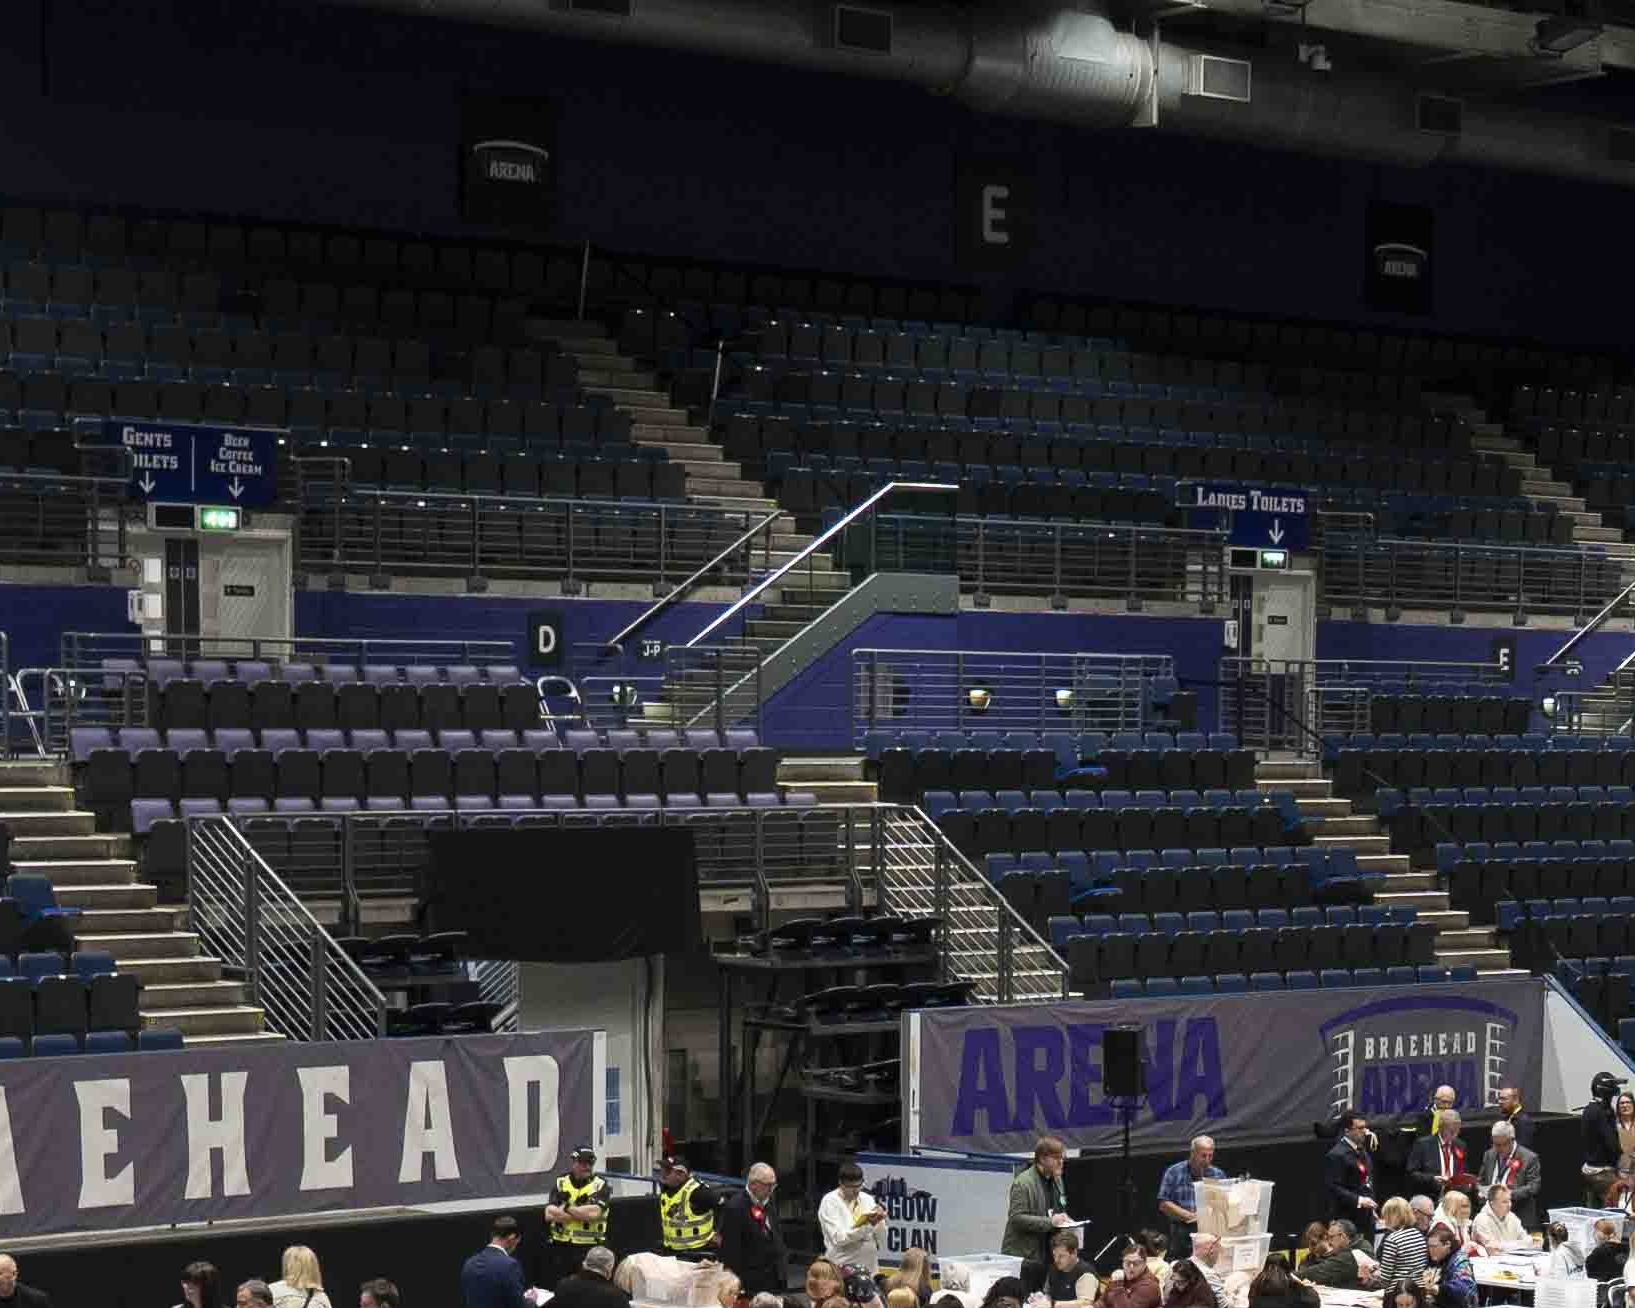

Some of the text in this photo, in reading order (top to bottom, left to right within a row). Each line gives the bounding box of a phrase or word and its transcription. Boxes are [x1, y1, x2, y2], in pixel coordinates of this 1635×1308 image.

[487, 161, 536, 184] ARENA
[982, 183, 1011, 245] E
[122, 426, 173, 449] GENTS
[133, 454, 179, 472] ILETS
[1196, 487, 1305, 515] LADIES TOILETS
[537, 624, 557, 655] D
[1364, 1031, 1477, 1060] BRAEHEAD
[950, 1018, 1228, 1137] ARENA
[1360, 1059, 1481, 1114] ARENA
[886, 1227, 938, 1255] CLAN
